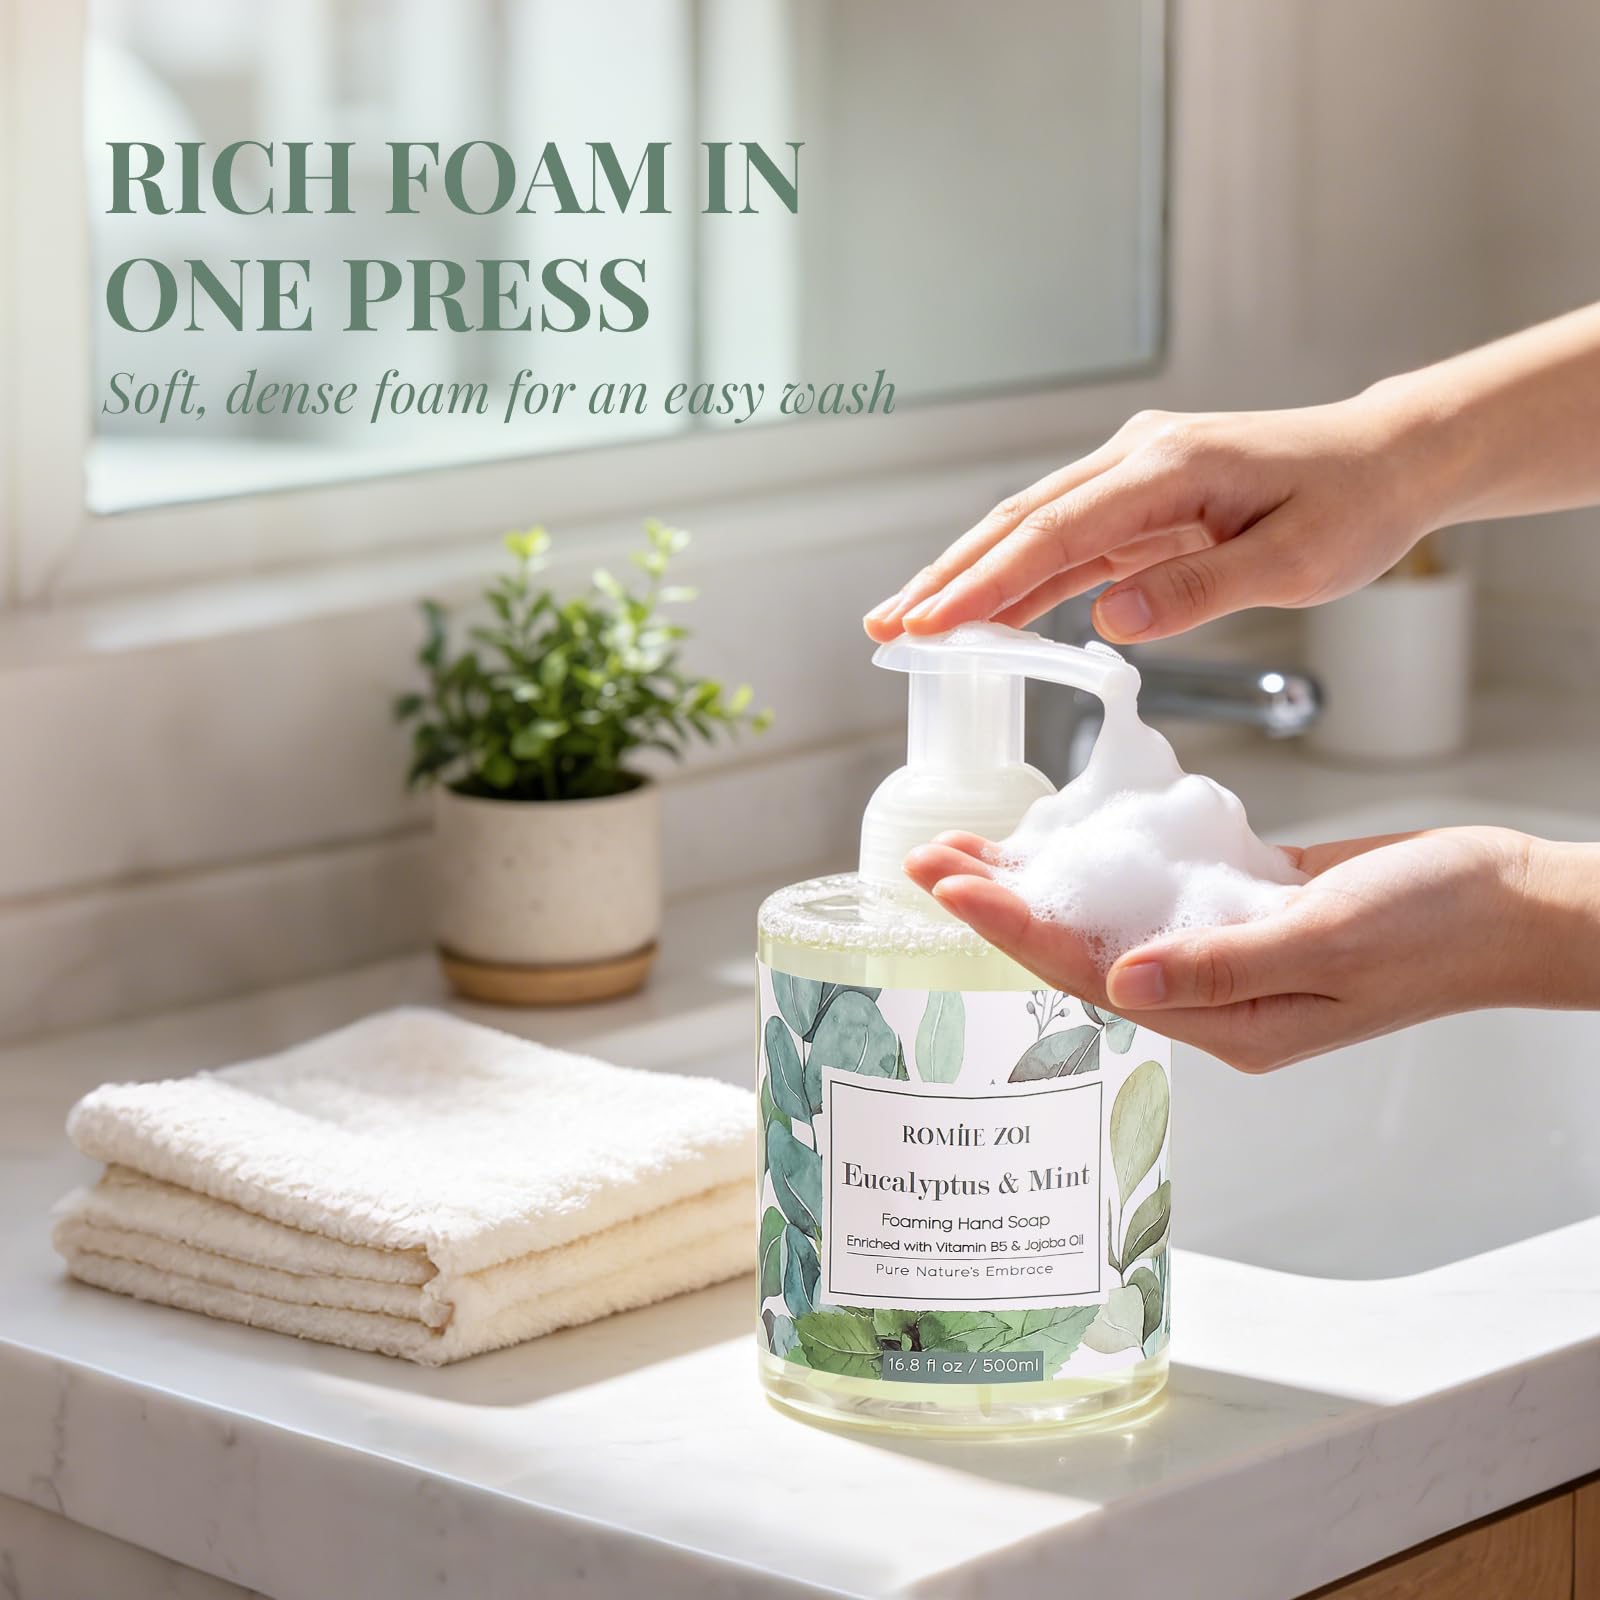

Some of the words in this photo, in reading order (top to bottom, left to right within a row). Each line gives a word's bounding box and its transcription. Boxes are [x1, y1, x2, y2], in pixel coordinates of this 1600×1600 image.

[993, 1125, 1031, 1146] ZOI
[841, 1161, 990, 1202] Eucalyptus
[998, 1172, 1019, 1195] &
[1028, 1163, 1090, 1192] Mint
[881, 1212, 953, 1233] Foaming
[958, 1215, 1004, 1231] Hand
[1007, 1215, 1051, 1230] Soap
[846, 1234, 901, 1251] Enriched
[903, 1241, 933, 1253] with
[935, 1241, 987, 1253] Vitamin
[990, 1240, 1008, 1253] B5
[1010, 1240, 1022, 1252] &
[1024, 1237, 1066, 1251] Jojoba
[1068, 1233, 1084, 1247] Oil
[876, 1263, 910, 1276] Pure
[916, 1265, 980, 1278] Nature's
[985, 1265, 1054, 1277] Embrace
[888, 1357, 920, 1372] 16.8
[926, 1357, 936, 1373] fl
[942, 1360, 963, 1374] oz
[968, 1358, 977, 1374] /
[983, 1358, 1039, 1373] 500ml
